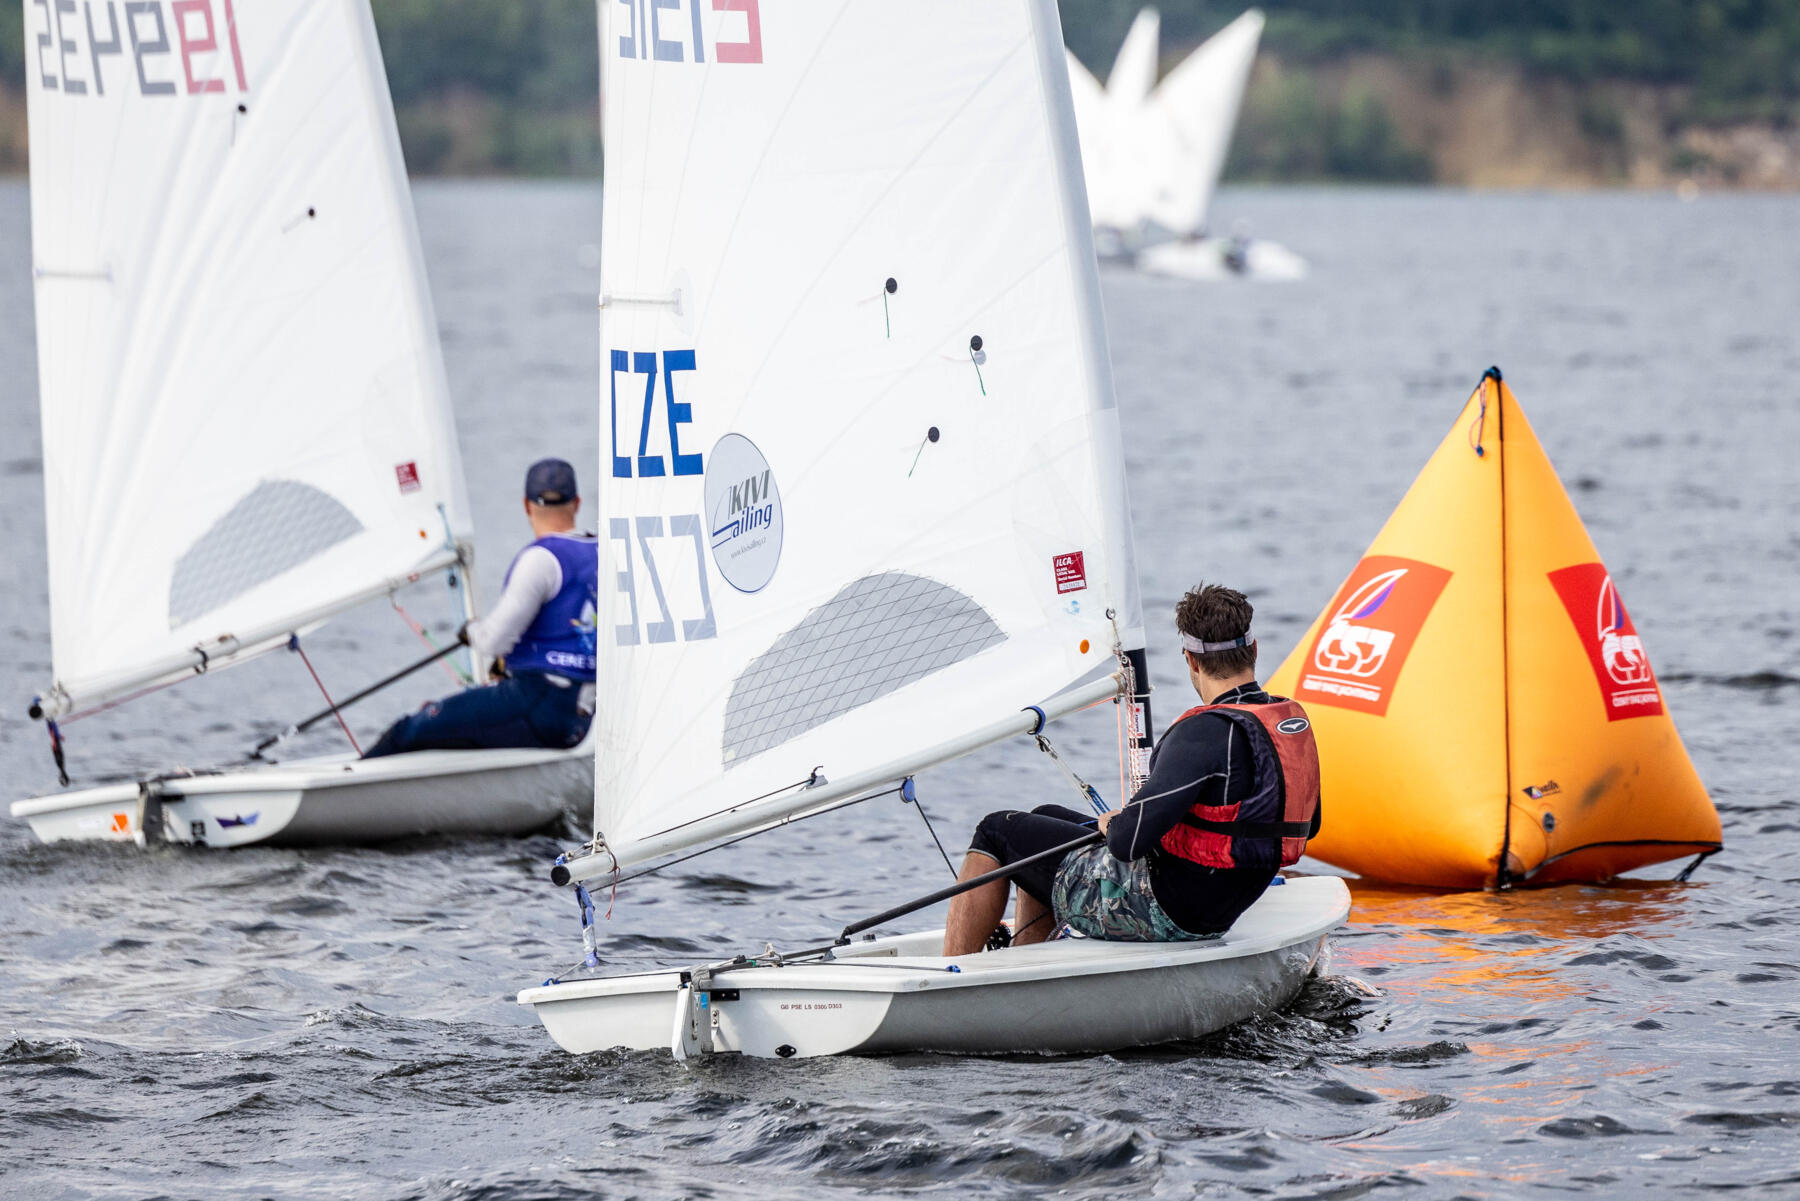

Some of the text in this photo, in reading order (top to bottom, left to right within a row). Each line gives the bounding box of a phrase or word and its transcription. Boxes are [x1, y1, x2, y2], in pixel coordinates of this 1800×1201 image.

[610, 349, 704, 478] CZE
[731, 469, 770, 515] KIVI
[1056, 556, 1073, 567] ILCA
